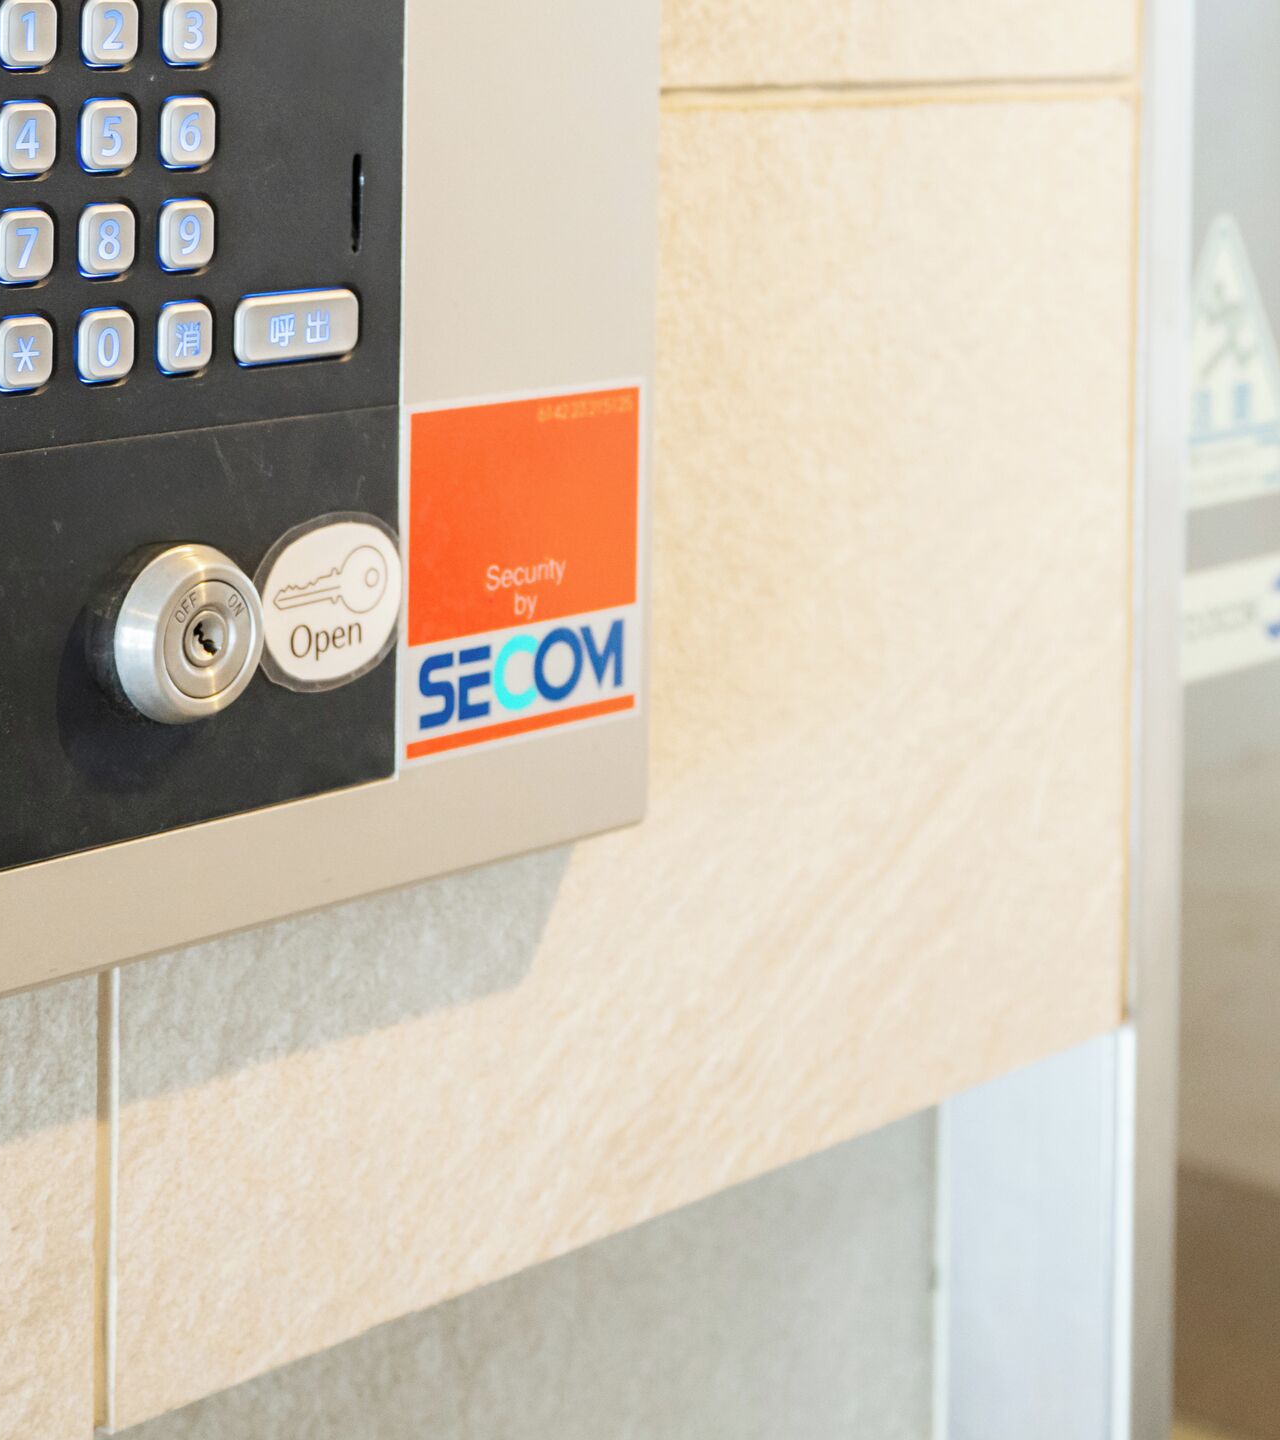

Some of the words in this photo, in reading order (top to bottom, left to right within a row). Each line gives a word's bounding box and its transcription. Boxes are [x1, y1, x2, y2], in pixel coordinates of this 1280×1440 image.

[20, 11, 36, 52] 1
[102, 9, 124, 51] 2
[182, 10, 204, 51] 3
[15, 118, 40, 160] 4
[101, 116, 122, 157] 5
[179, 112, 201, 152] 6
[15, 227, 39, 269] 7
[97, 218, 120, 260] 8
[179, 214, 201, 255] 9
[97, 326, 120, 368] 0
[175, 321, 202, 358] 消
[486, 557, 566, 591] Security
[174, 592, 197, 624] OFF
[228, 593, 246, 617] ON
[514, 593, 538, 619] by
[290, 622, 363, 661] Open
[419, 619, 624, 730] SECOM
